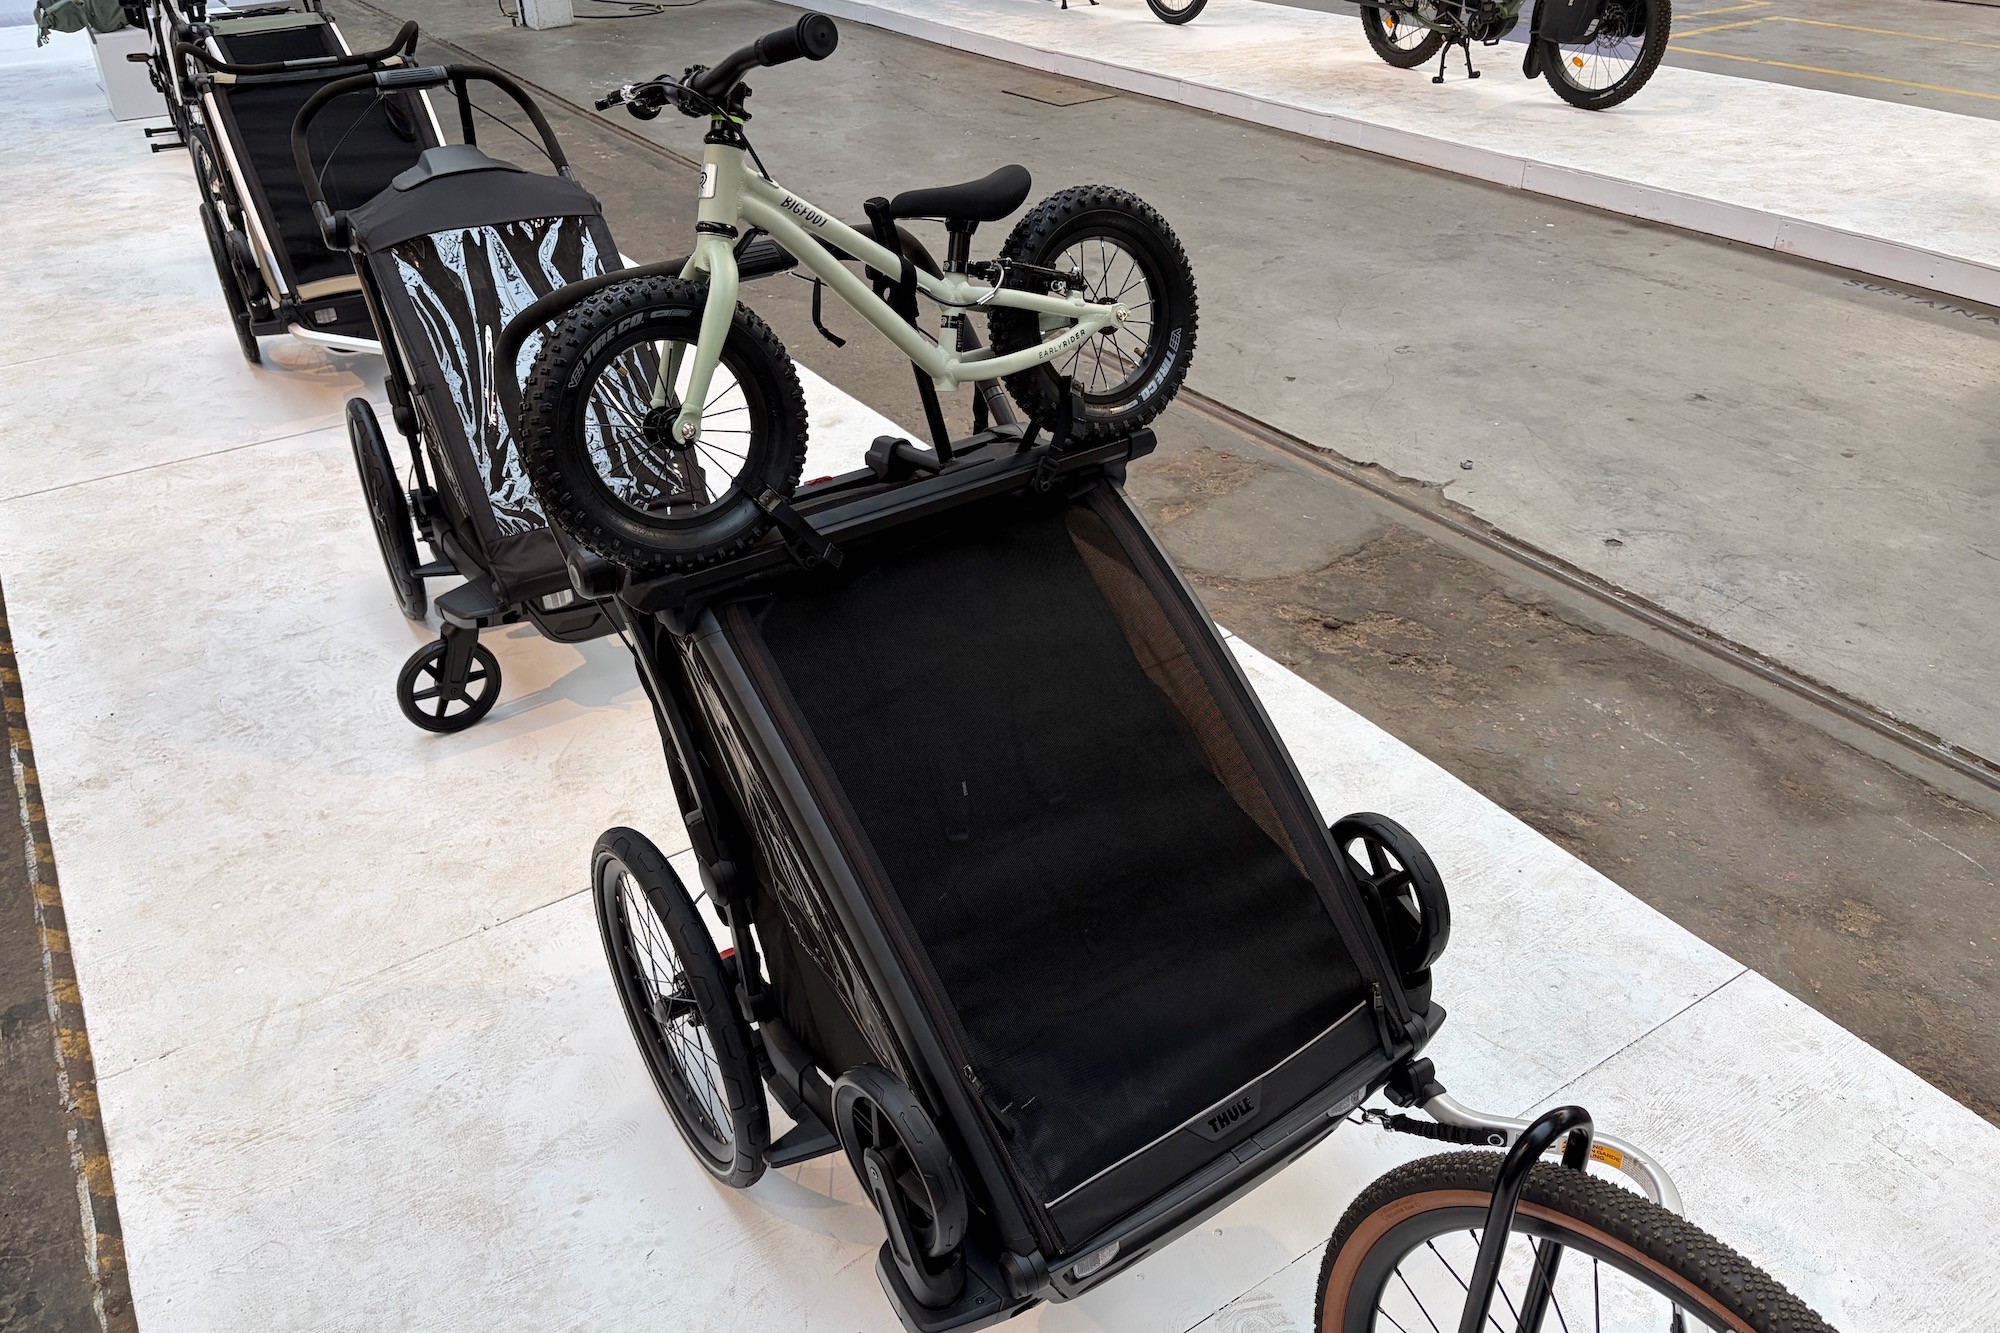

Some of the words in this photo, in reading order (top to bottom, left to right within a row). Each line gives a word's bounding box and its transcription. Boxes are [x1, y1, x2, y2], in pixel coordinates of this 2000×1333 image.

[780, 195, 829, 228] BIGFOOT
[583, 325, 617, 365] TIRE
[1154, 350, 1177, 385] TIRE
[1207, 1096, 1255, 1134] THULE
